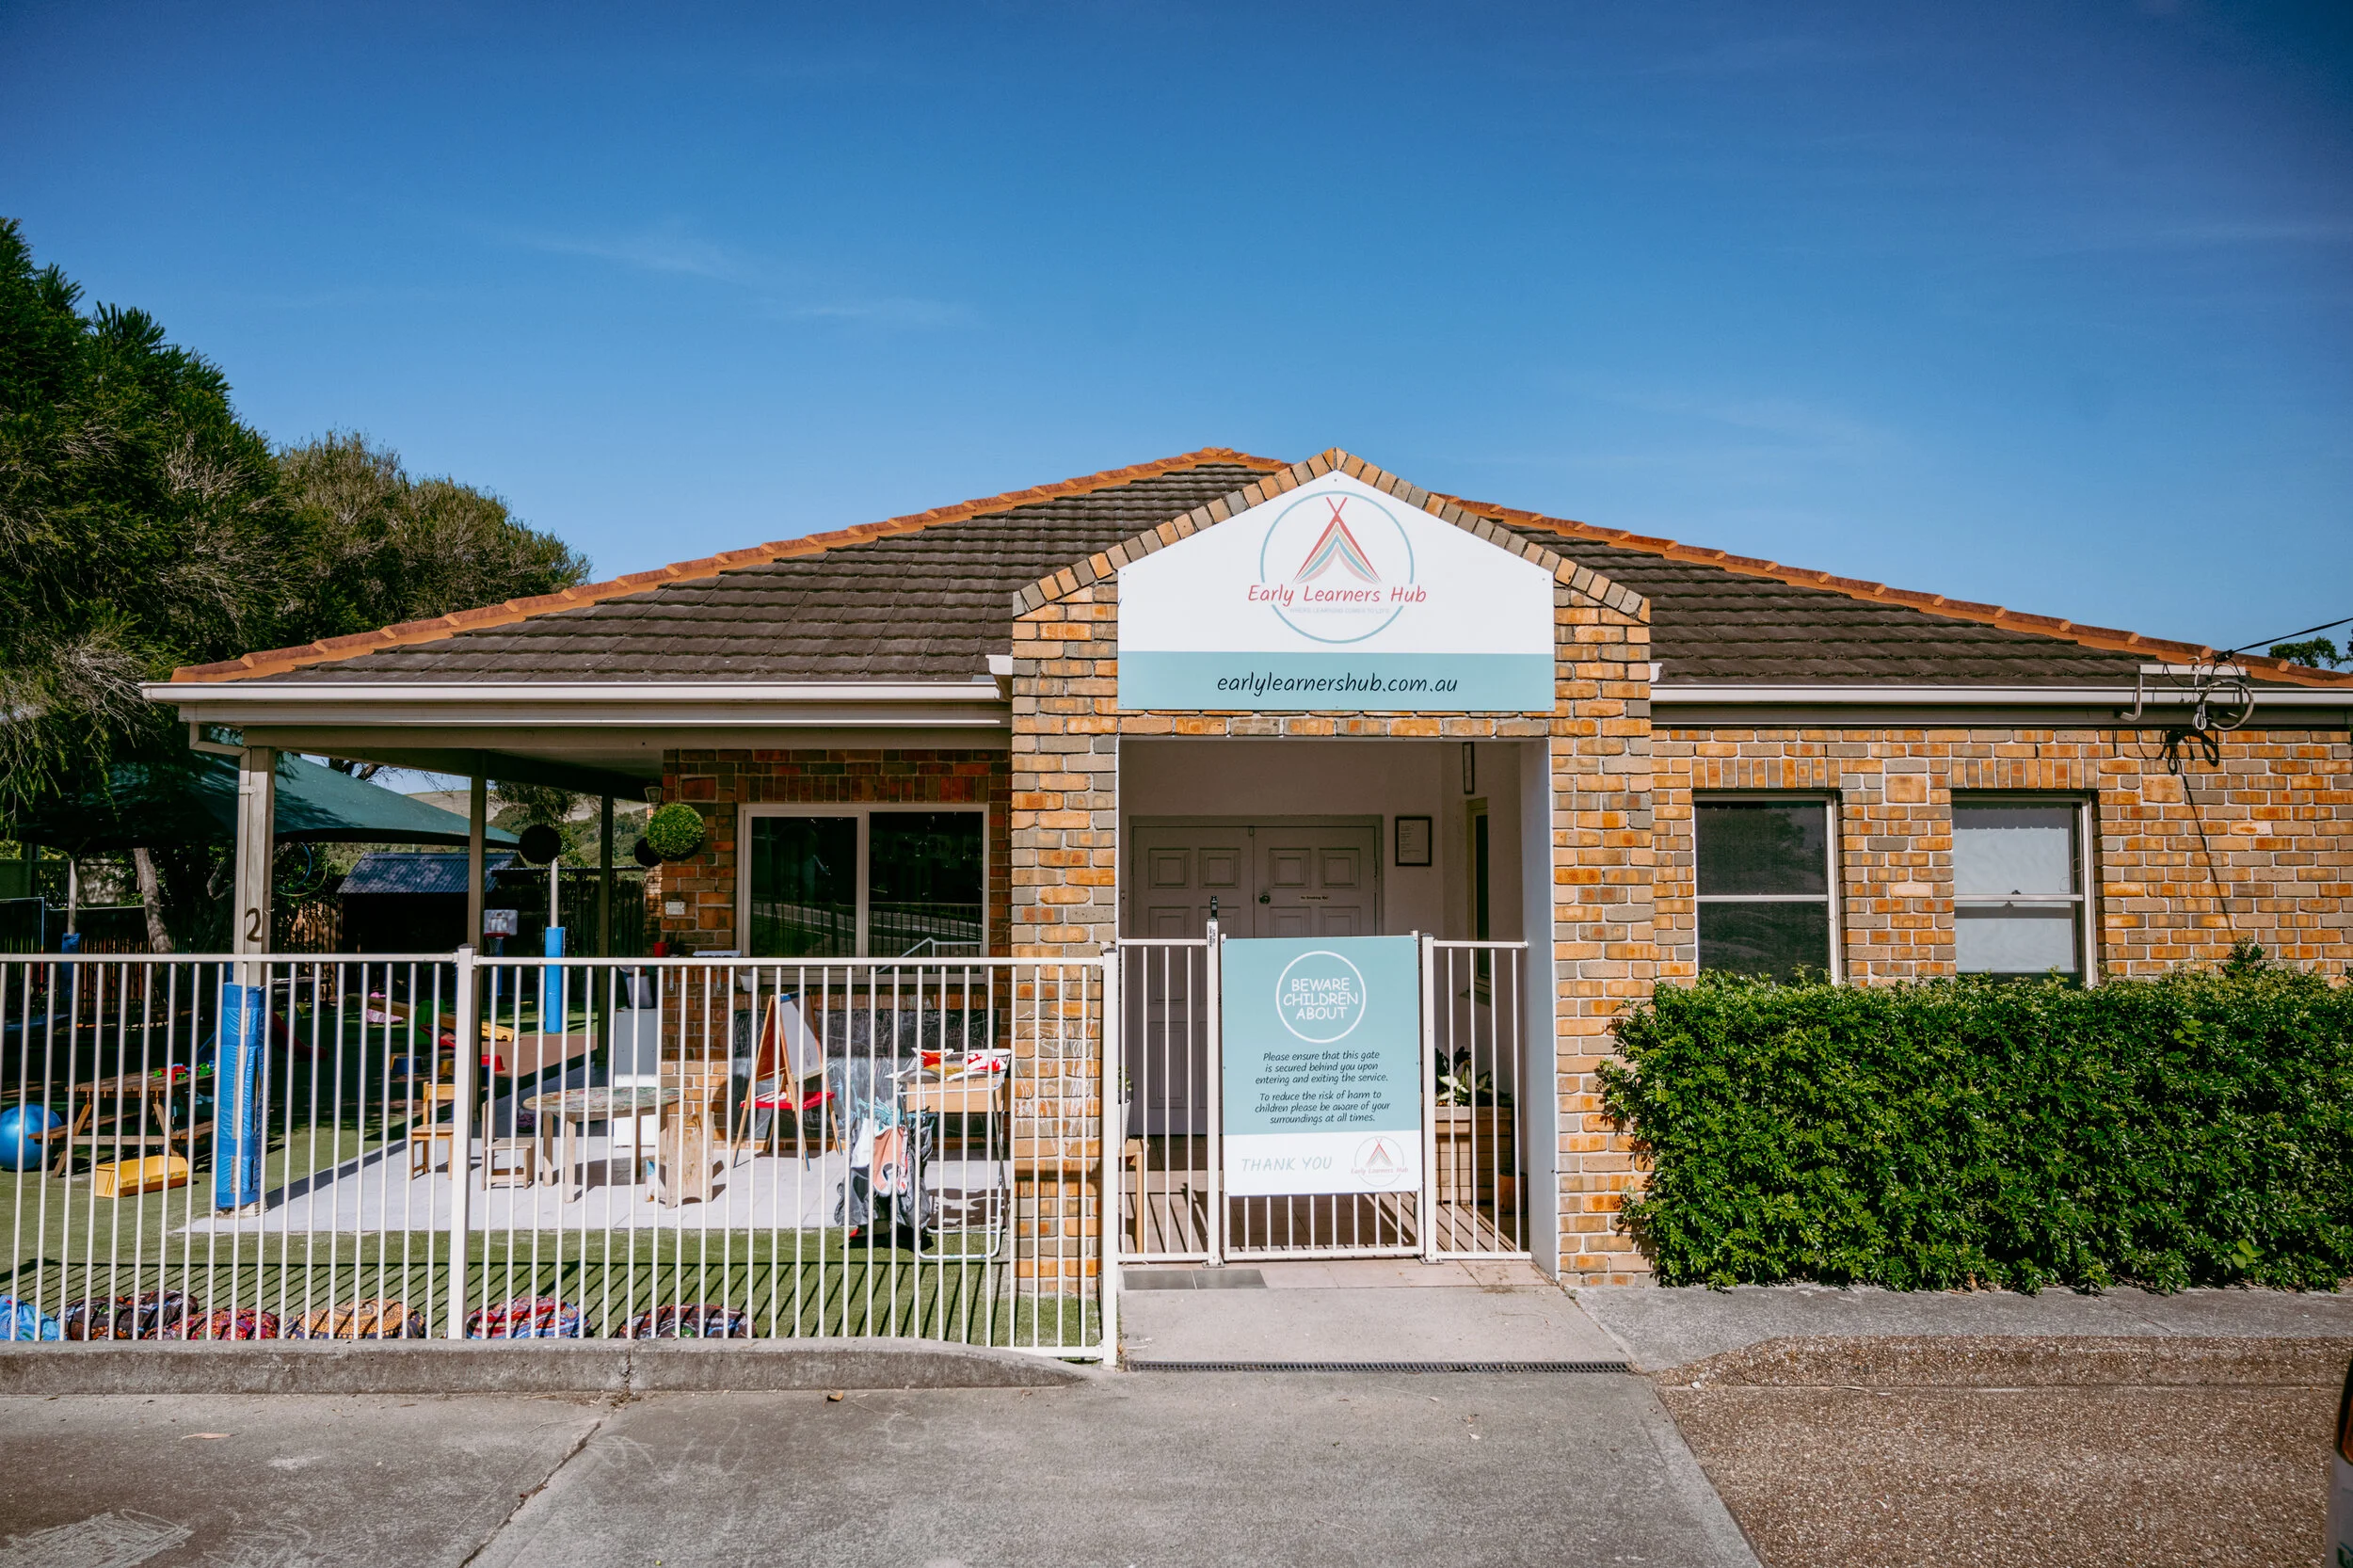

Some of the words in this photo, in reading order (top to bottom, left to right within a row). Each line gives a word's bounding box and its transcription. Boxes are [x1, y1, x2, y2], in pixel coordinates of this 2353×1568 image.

[1248, 584, 1294, 607] Early
[1304, 584, 1381, 602] Learners
[1390, 584, 1427, 602] Hub
[1217, 671, 1458, 697] earlylearnershub.com.au
[1291, 977, 1351, 992] BEWARE
[1283, 991, 1359, 1006] CHILDREN
[1295, 1006, 1349, 1020] ABOUT
[1263, 1051, 1290, 1062] Please
[1291, 1052, 1320, 1061] ensure
[1321, 1050, 1340, 1061] that
[1342, 1049, 1359, 1061] this
[1360, 1050, 1381, 1063] gate
[1265, 1064, 1273, 1073] is
[1274, 1063, 1307, 1073] secured
[1309, 1062, 1338, 1072] behind
[1339, 1064, 1355, 1074] you
[1357, 1063, 1379, 1073] upon
[1255, 1075, 1290, 1086] entering
[1292, 1073, 1309, 1083] and
[1310, 1074, 1339, 1085] exiting
[1341, 1072, 1355, 1082] the
[1357, 1072, 1388, 1082] service.
[1259, 1093, 1270, 1101] To
[1272, 1091, 1300, 1101] reduce
[1302, 1091, 1317, 1100] the
[1319, 1091, 1335, 1100] risk
[1336, 1089, 1347, 1100] of
[1347, 1090, 1370, 1100] harm
[1372, 1089, 1383, 1099] to
[1255, 1102, 1289, 1113] children
[1290, 1102, 1318, 1114] please
[1320, 1101, 1330, 1112] be
[1332, 1103, 1359, 1112] aware
[1360, 1100, 1371, 1111] of
[1370, 1101, 1391, 1112] your
[1270, 1113, 1323, 1126] surroundings
[1324, 1113, 1335, 1123] at
[1337, 1112, 1348, 1123] all
[1349, 1112, 1376, 1123] times.
[1241, 1157, 1297, 1172] THANK
[1302, 1156, 1333, 1171] YOU
